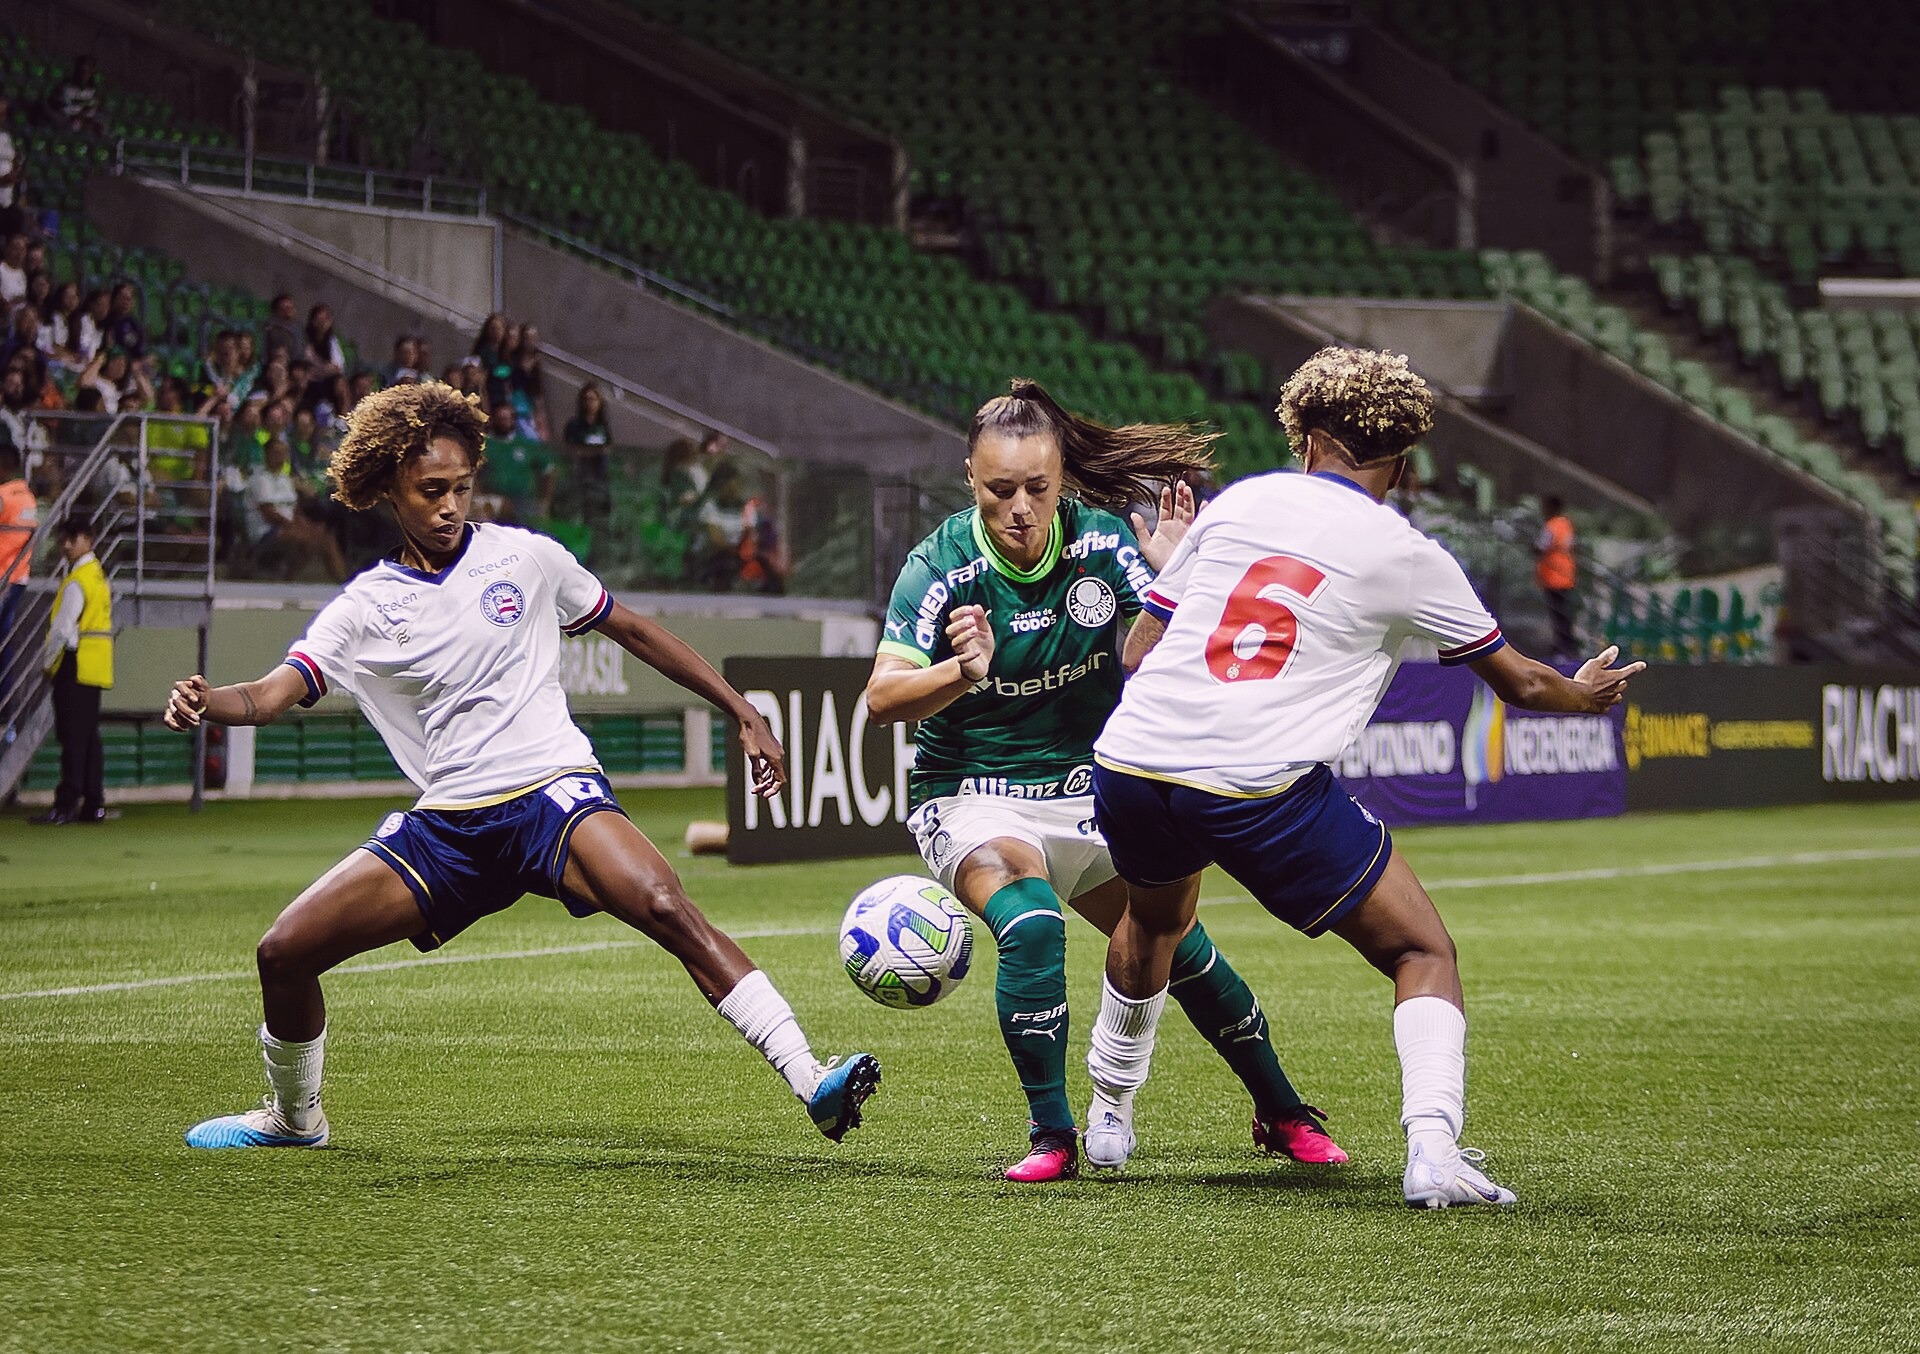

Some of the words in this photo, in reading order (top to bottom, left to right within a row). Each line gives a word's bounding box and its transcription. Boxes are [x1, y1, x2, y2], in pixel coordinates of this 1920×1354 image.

[1009, 614, 1057, 633] TODOS
[1071, 594, 1113, 624] PALMEIRAS
[1205, 556, 1330, 684] 6
[994, 652, 1108, 696] betfair
[957, 776, 1058, 799] Allianz
